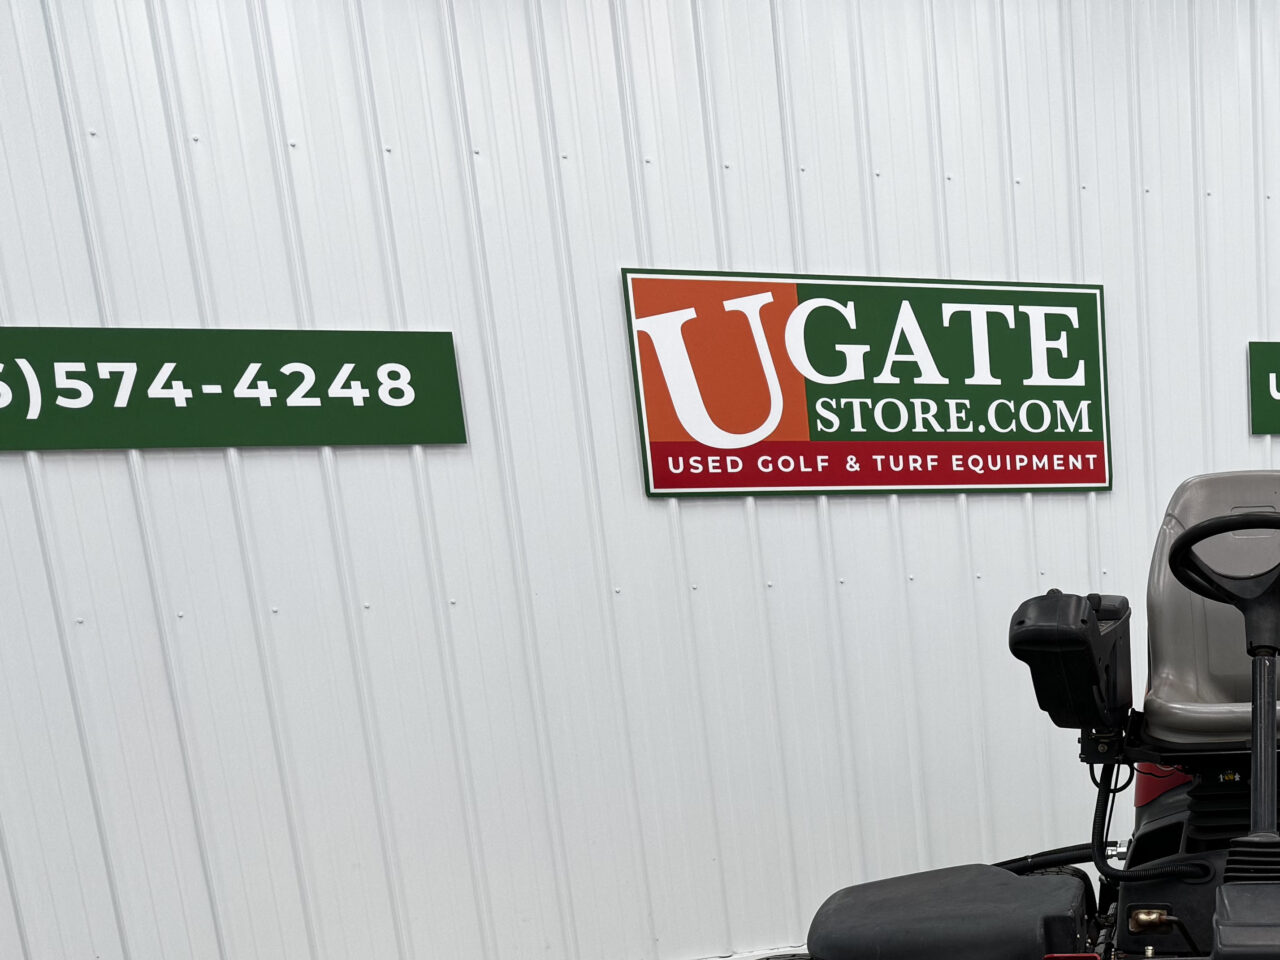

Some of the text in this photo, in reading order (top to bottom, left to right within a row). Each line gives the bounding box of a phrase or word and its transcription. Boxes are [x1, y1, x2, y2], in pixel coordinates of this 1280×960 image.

[815, 397, 1093, 433] STORE.COM
[667, 454, 1098, 474] USED GOLF & TURF EQUIPMENT
